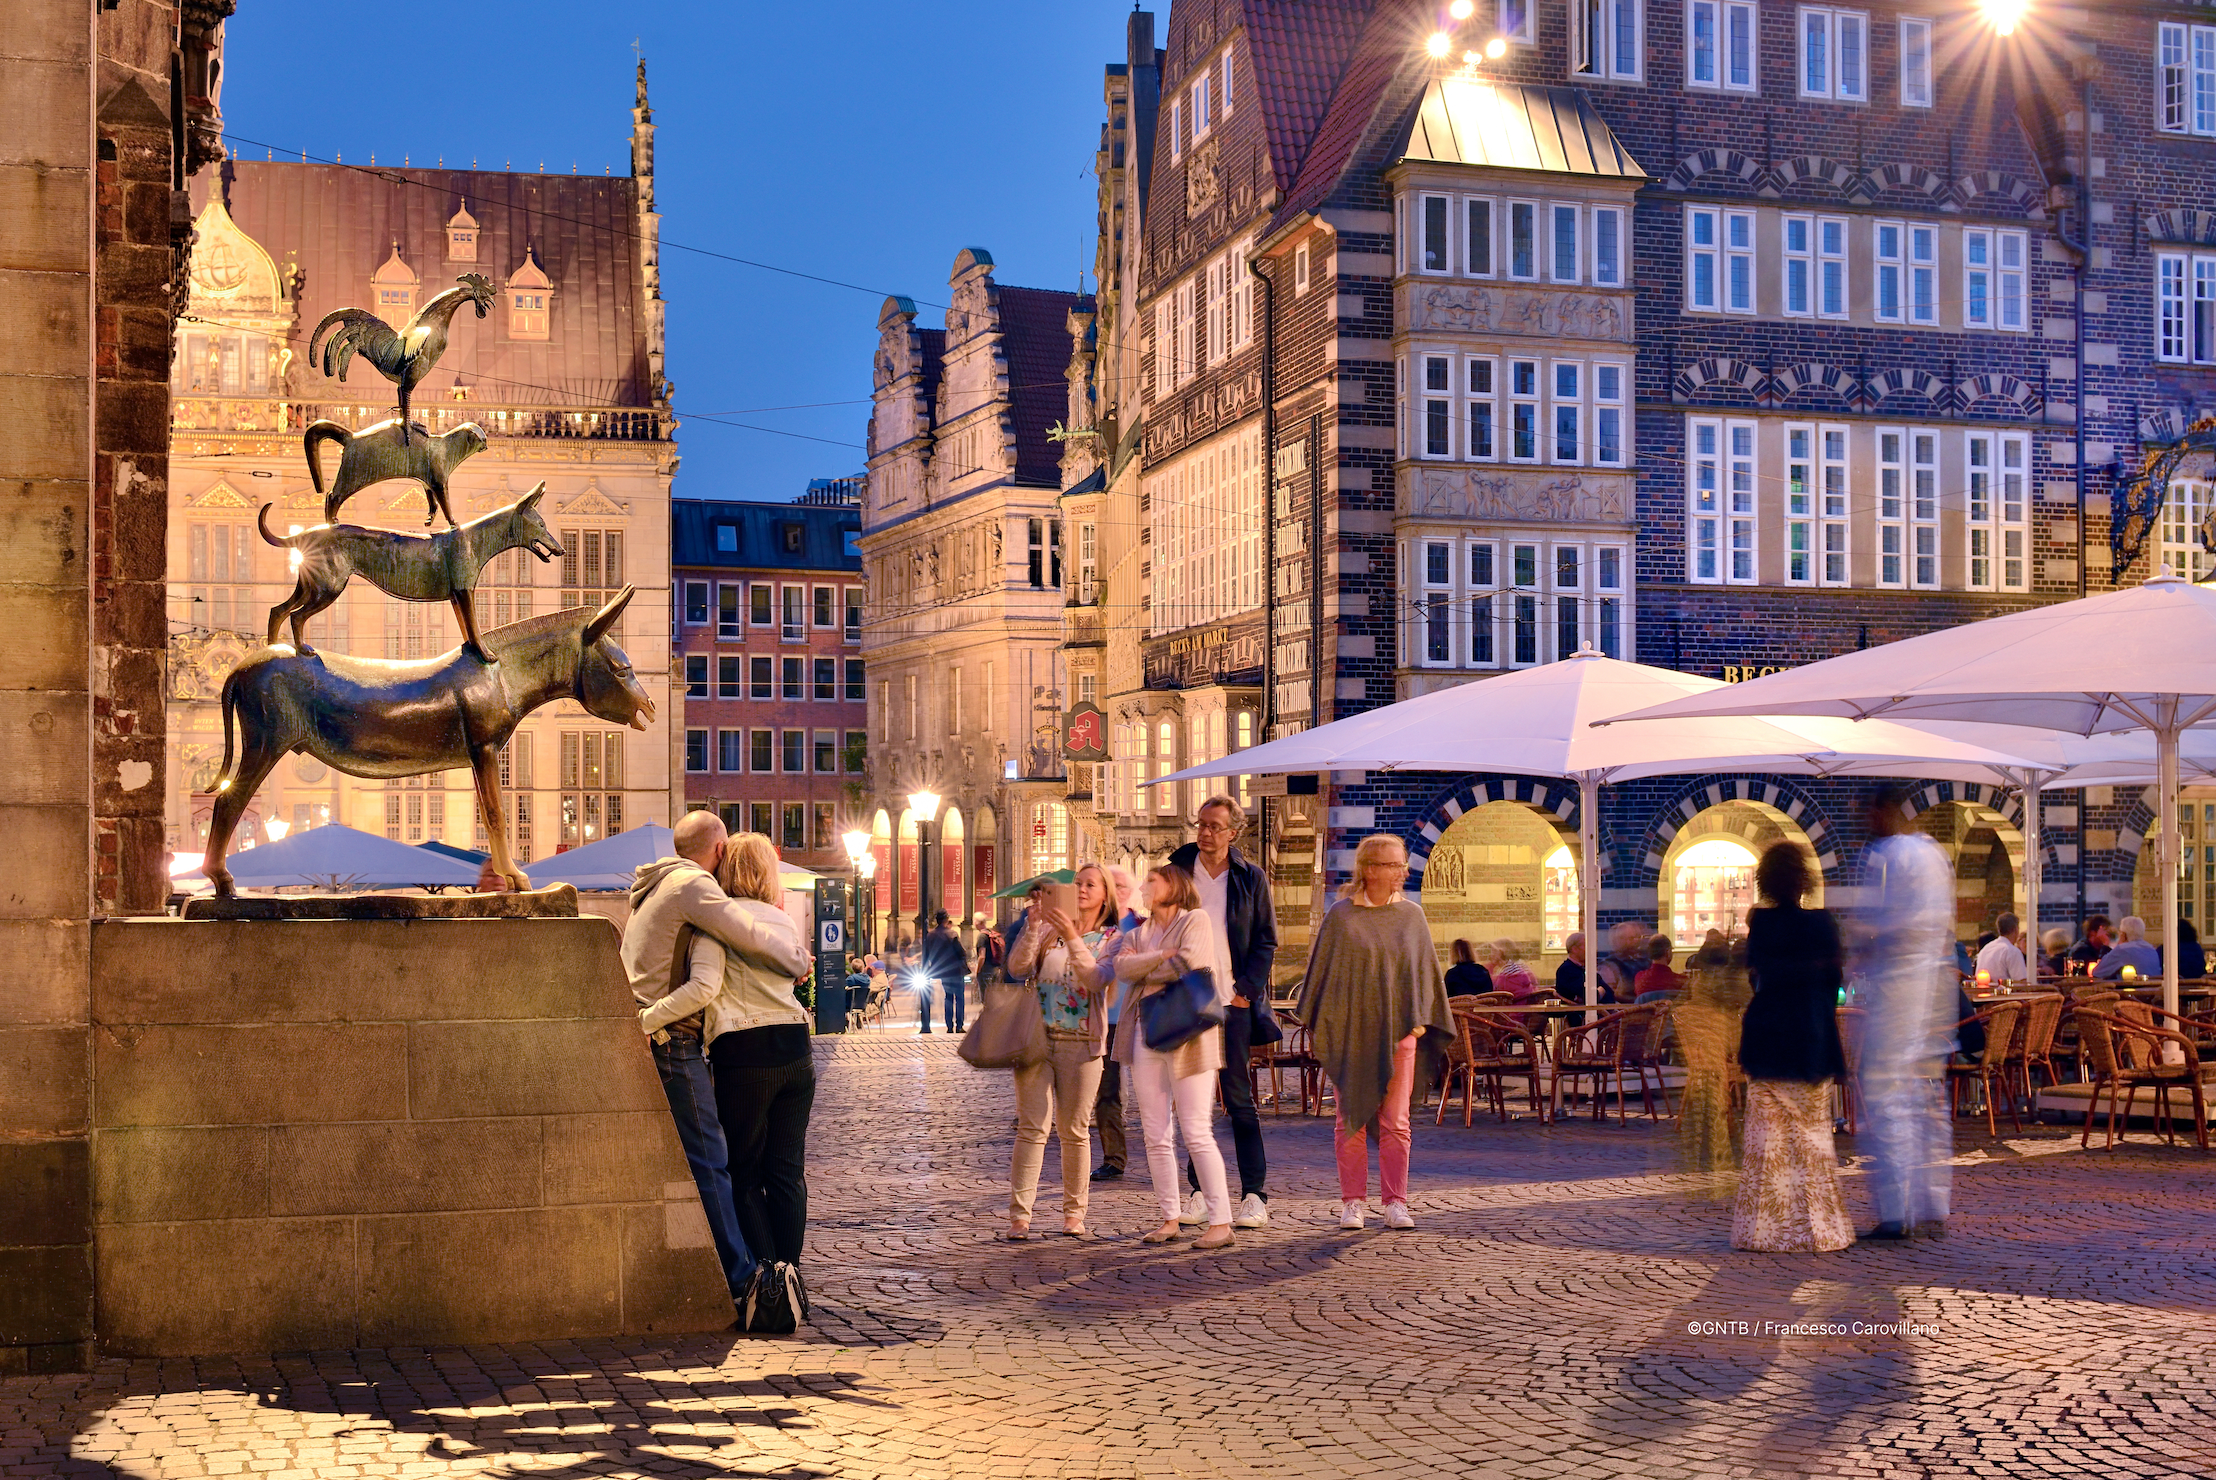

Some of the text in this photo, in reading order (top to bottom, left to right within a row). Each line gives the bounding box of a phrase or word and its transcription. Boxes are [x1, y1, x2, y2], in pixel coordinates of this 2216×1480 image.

[1276, 561, 1304, 598] DIE DAS
[1203, 627, 1229, 649] MARKT
[1723, 666, 1796, 684] BEC
